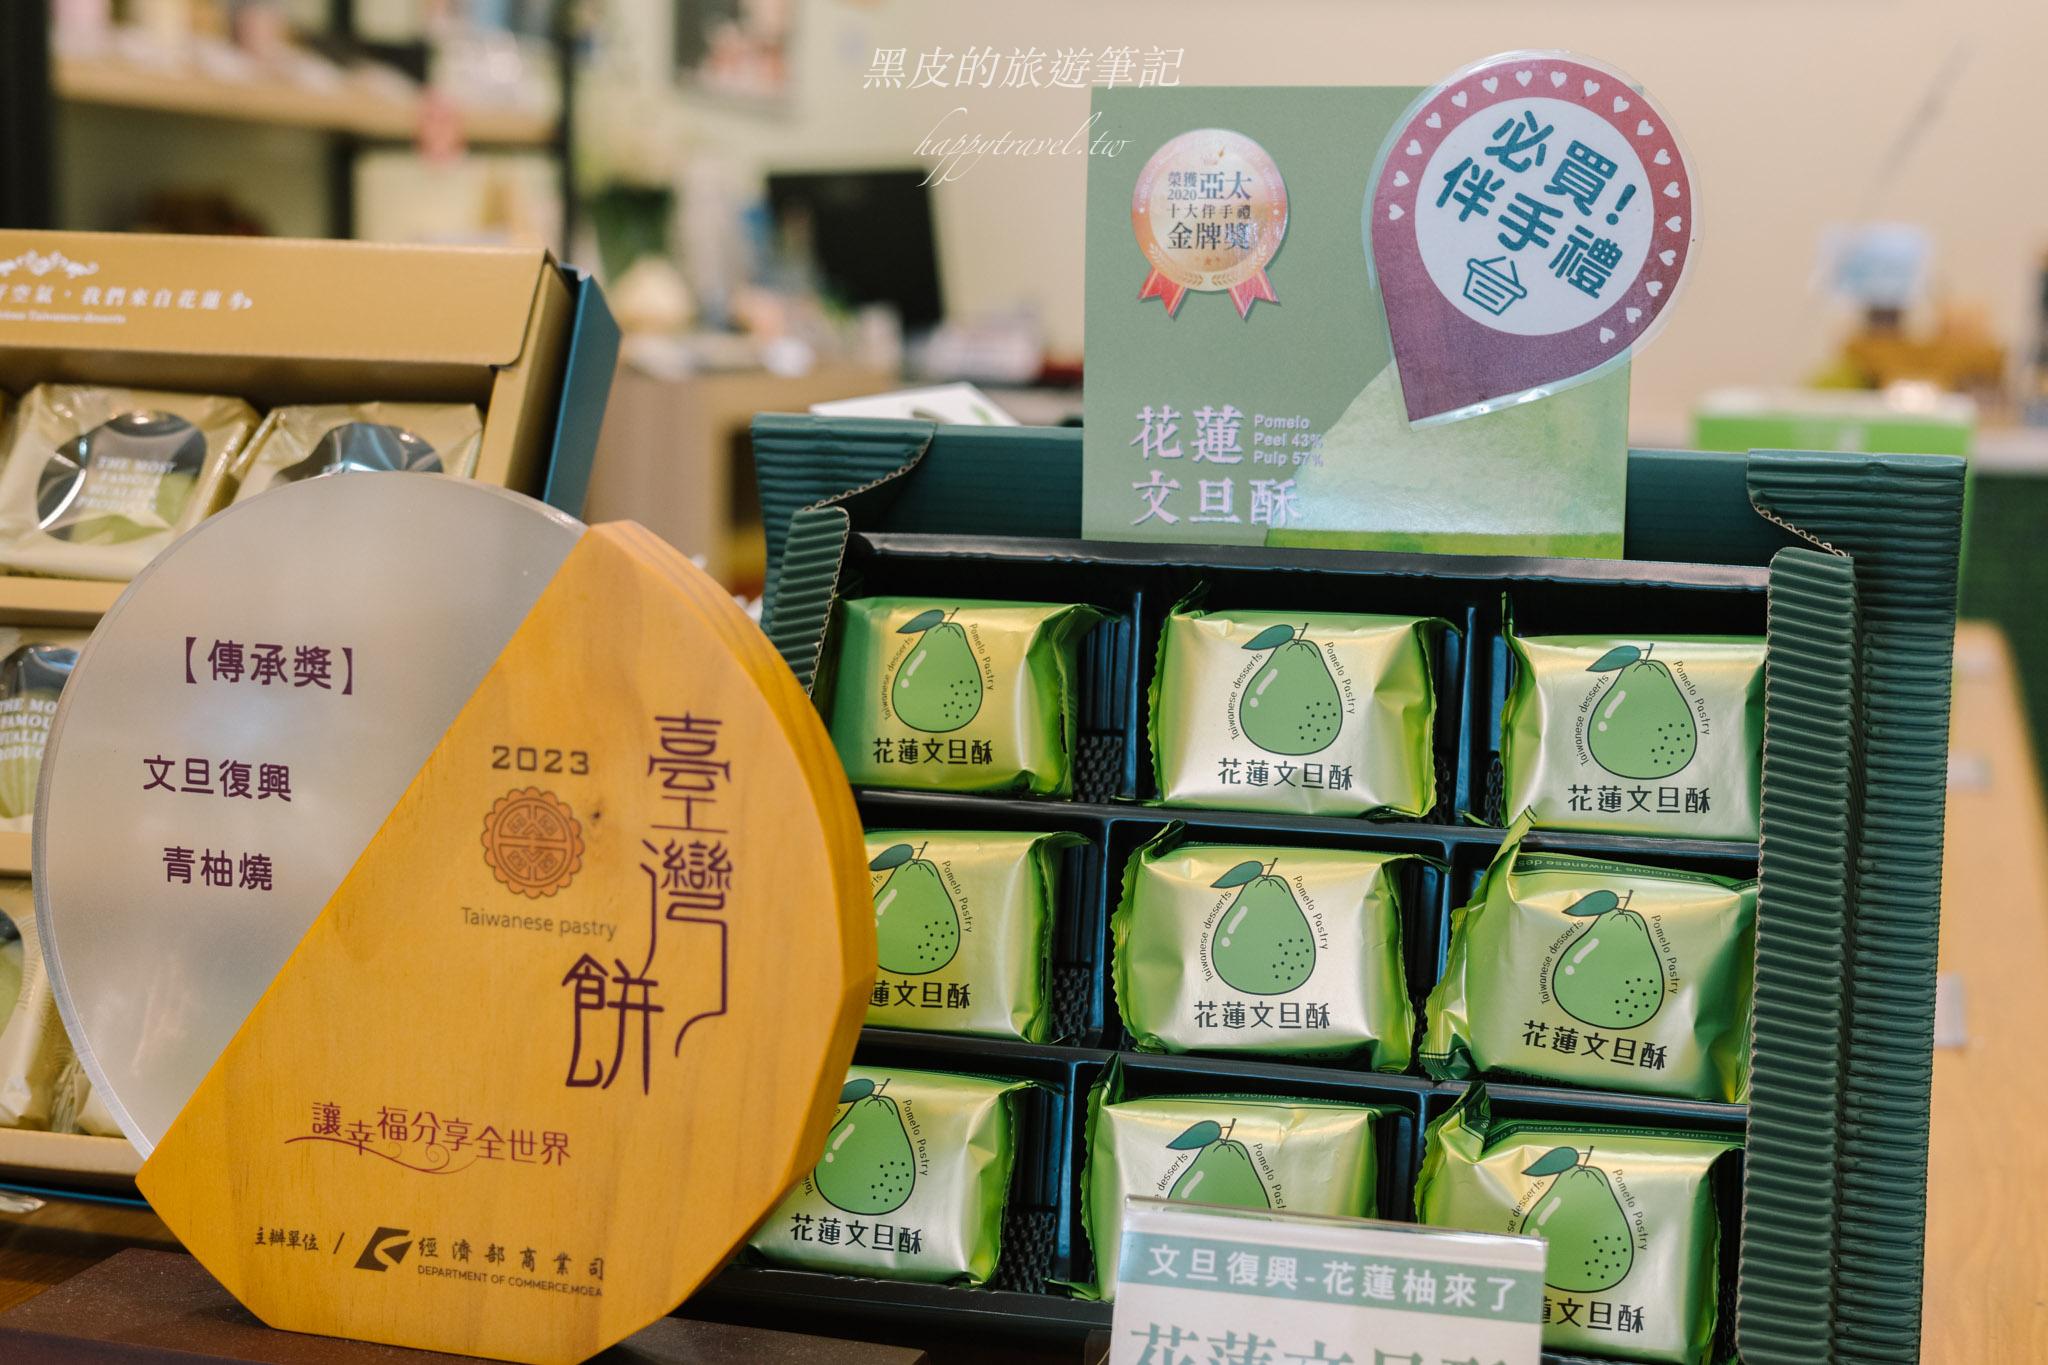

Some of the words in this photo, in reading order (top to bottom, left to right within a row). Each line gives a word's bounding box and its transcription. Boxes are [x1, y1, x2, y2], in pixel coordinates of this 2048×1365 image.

[1167, 188, 1198, 200] 2020
[1199, 170, 1252, 200] 亞太
[1167, 203, 1251, 219] 十大伴手禮
[1435, 156, 1623, 299] 伴手禮
[1130, 405, 1244, 464] 花蓮
[1253, 414, 1311, 429] Pomelo
[1253, 432, 1287, 447] Peel
[1292, 433, 1324, 449] 43%
[1253, 451, 1287, 467] Pulp
[1131, 469, 1302, 526] 文旦酥
[1325, 641, 1345, 676] Pomelo
[1342, 678, 1355, 715] Pastry
[1673, 661, 1696, 696] Pomelo
[1694, 698, 1710, 735] Pastry
[492, 745, 590, 776] 2023
[873, 738, 992, 765] 花蓮文旦酥
[143, 755, 291, 802] 文旦復興
[1218, 758, 1353, 790] 花蓮文旦酥
[1567, 784, 1711, 813] 花蓮文旦酥
[163, 846, 273, 891] 青柚燒
[942, 860, 961, 895] Pomelo
[960, 897, 974, 933] Pastry
[1294, 875, 1315, 911] Pomelo
[1312, 912, 1329, 950] Pastry
[461, 906, 554, 933] Taiwanese
[559, 914, 618, 942] pastry
[1652, 914, 1671, 953] Pomelo
[1667, 957, 1681, 994] Pastry
[869, 980, 970, 1009] 蓮文旦酥
[1194, 1001, 1330, 1029] 花蓮文旦酥
[1522, 1020, 1667, 1071] 花蓮文旦酥
[311, 1101, 571, 1167] 讓幸福分享全世界
[903, 1099, 920, 1136] Pomelo
[917, 1138, 928, 1176] Pastry
[1254, 1143, 1275, 1182] Pomelo
[1614, 1169, 1634, 1208] Pomelo
[1632, 1211, 1647, 1251] Pastry
[254, 1226, 319, 1251] 主辦單位
[790, 1213, 922, 1254] 花蓮文旦酥
[417, 1264, 489, 1283] DEPARTMENT
[490, 1274, 505, 1285] OF
[418, 1237, 605, 1281] 經濟部商業司
